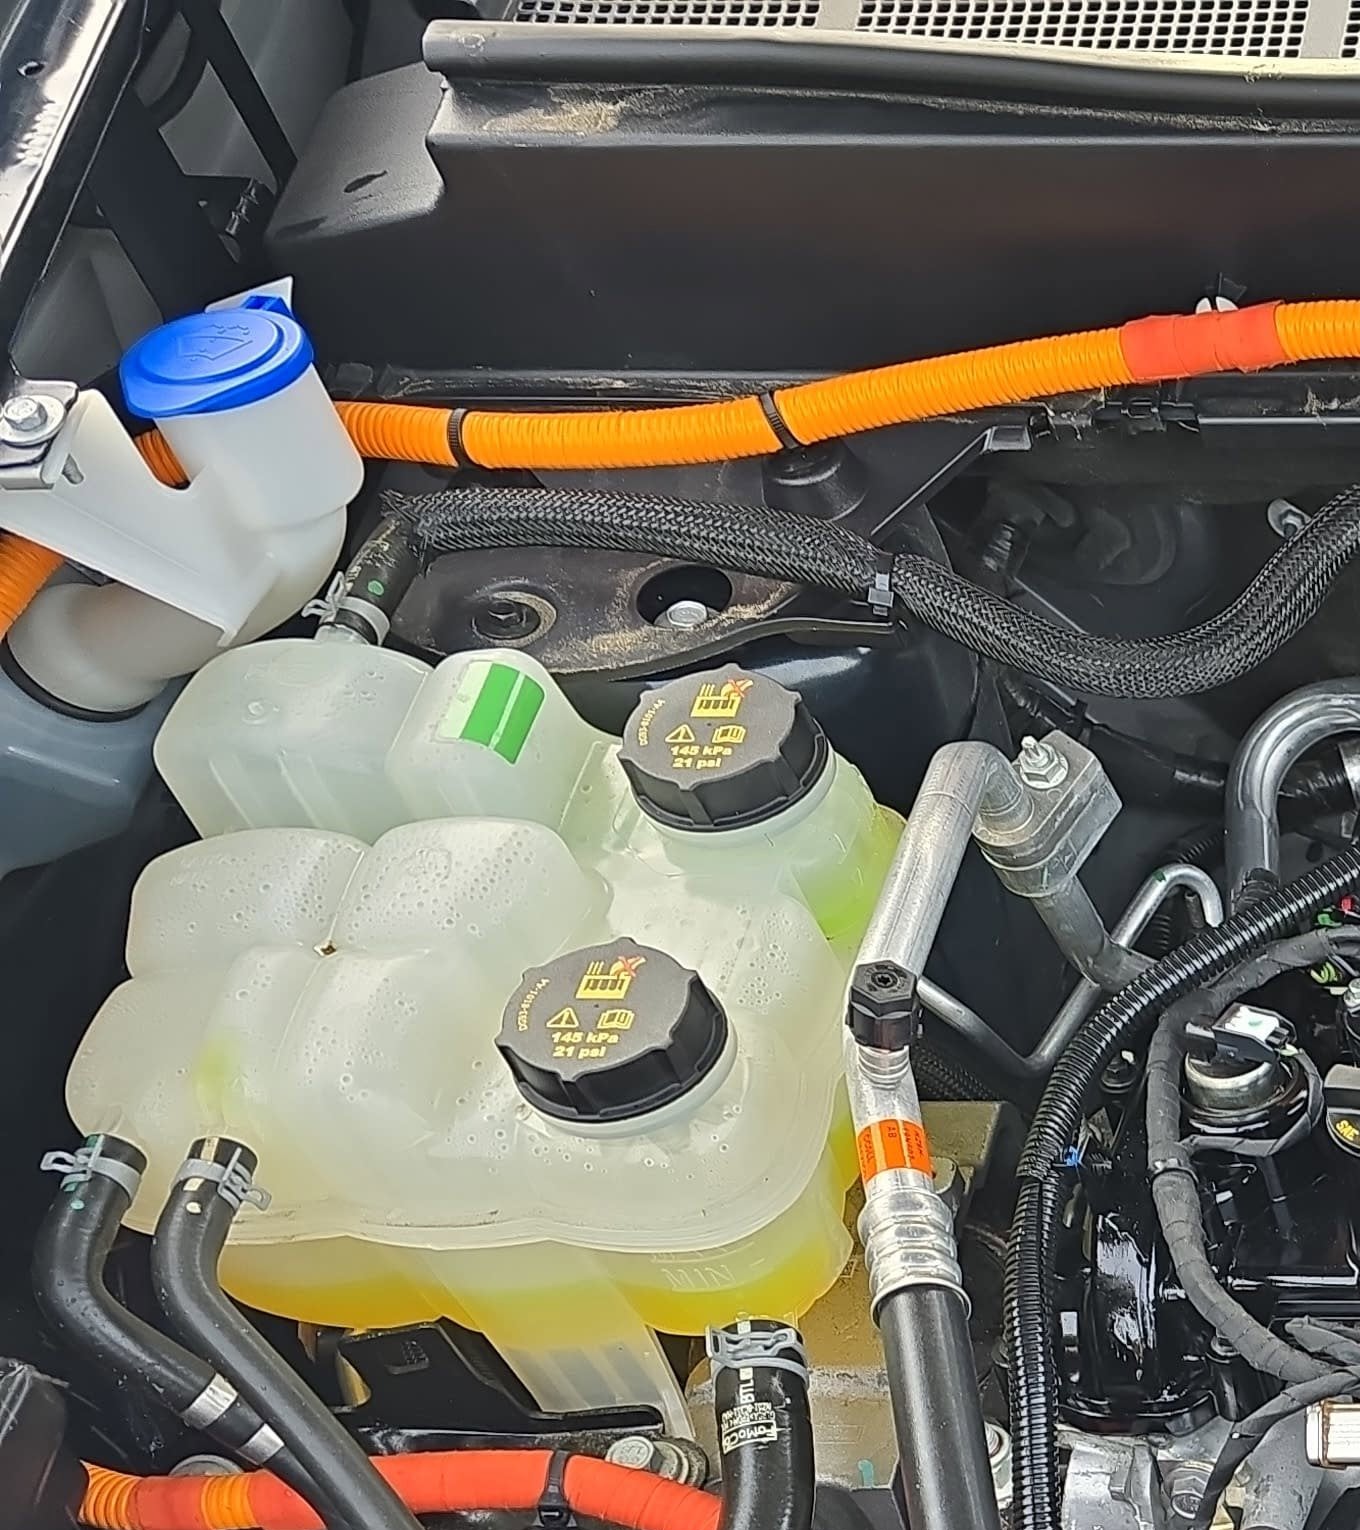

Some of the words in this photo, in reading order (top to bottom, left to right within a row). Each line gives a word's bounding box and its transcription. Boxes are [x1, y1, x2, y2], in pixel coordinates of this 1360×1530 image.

[670, 745, 700, 756] 145
[702, 745, 733, 756] kPa
[672, 757, 692, 768] 21
[551, 1031, 583, 1043] 145
[585, 1031, 619, 1043] kPa
[553, 1046, 575, 1057] 21
[1335, 1119, 1359, 1141] SAE
